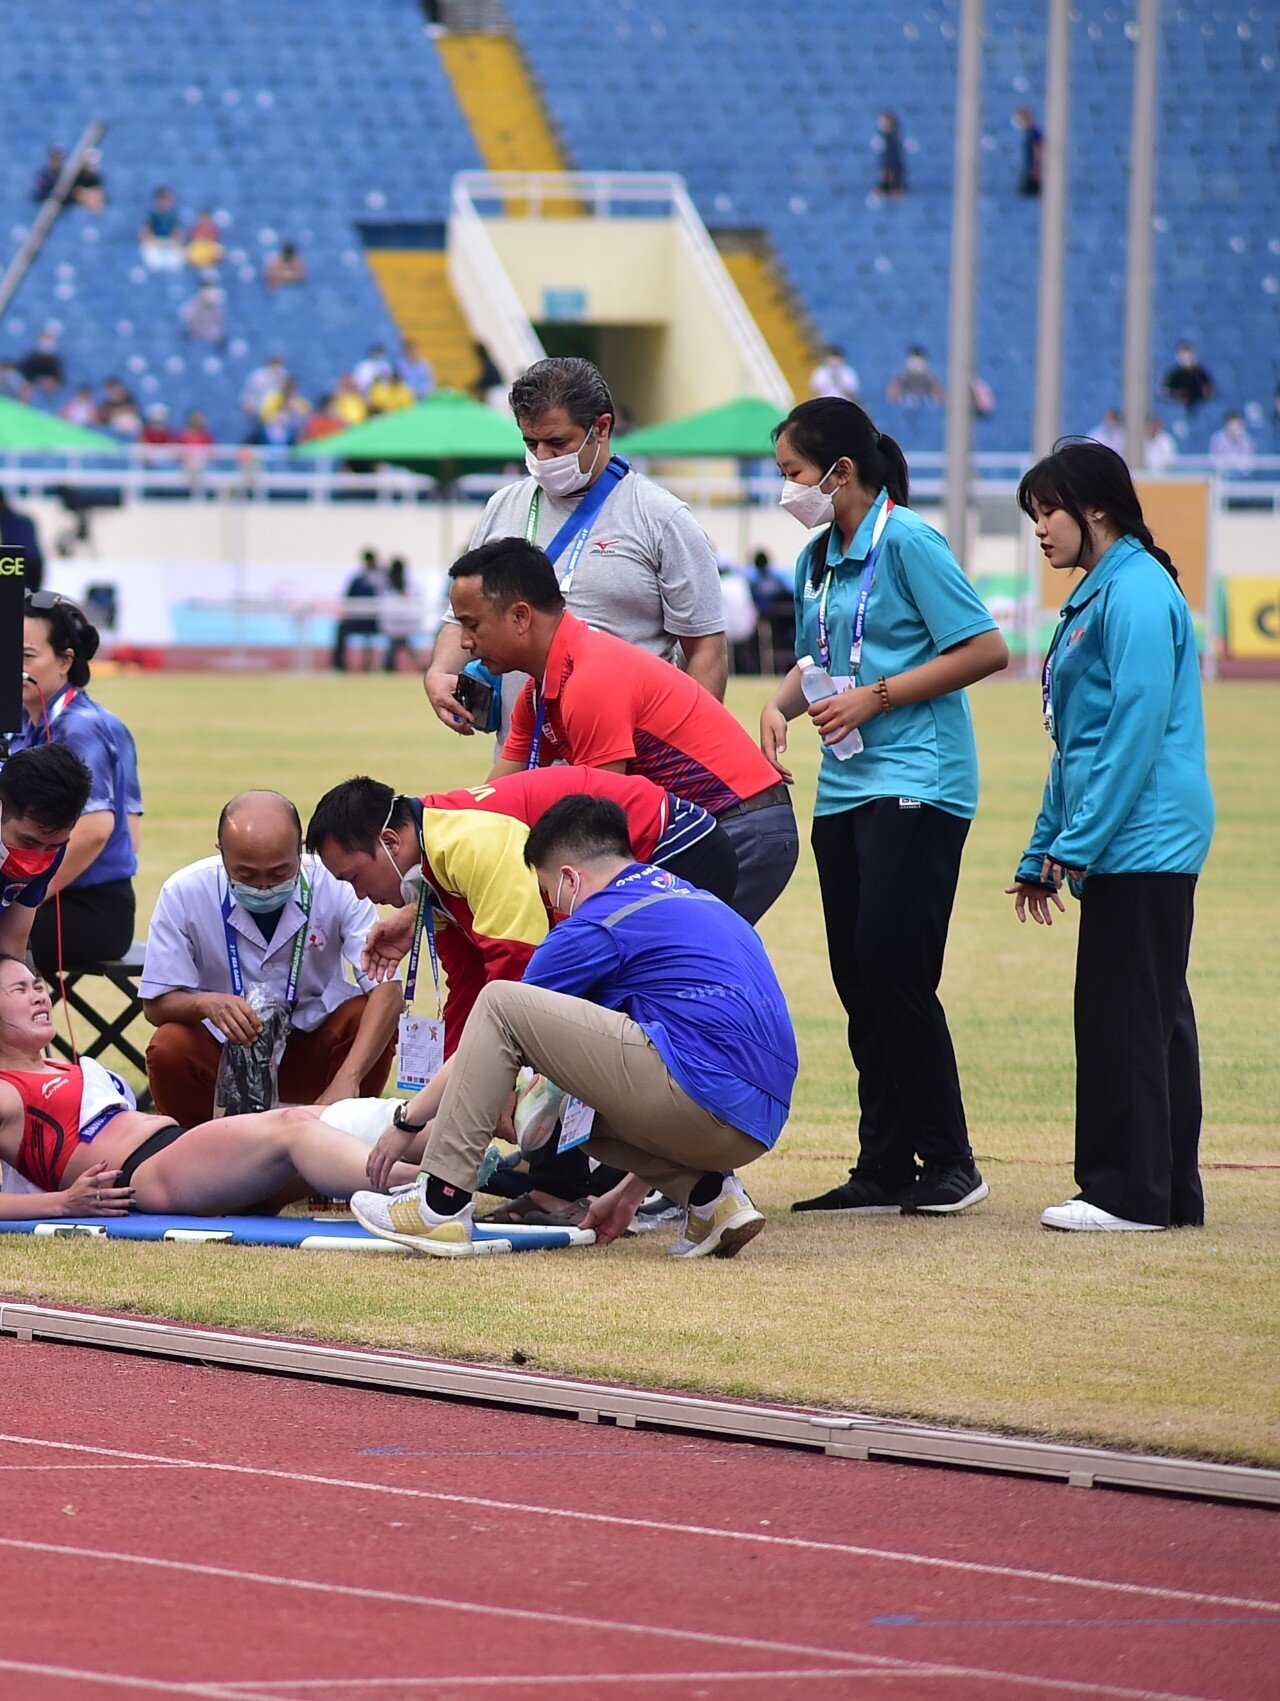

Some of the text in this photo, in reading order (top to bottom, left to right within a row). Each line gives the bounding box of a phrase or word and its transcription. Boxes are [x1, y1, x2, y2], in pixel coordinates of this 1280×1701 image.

[855, 616, 863, 637] GAMES
[413, 916, 422, 954] SOUTHEAST
[290, 947, 301, 984] SOUTHEAST
[287, 985, 295, 1000] ASIA
